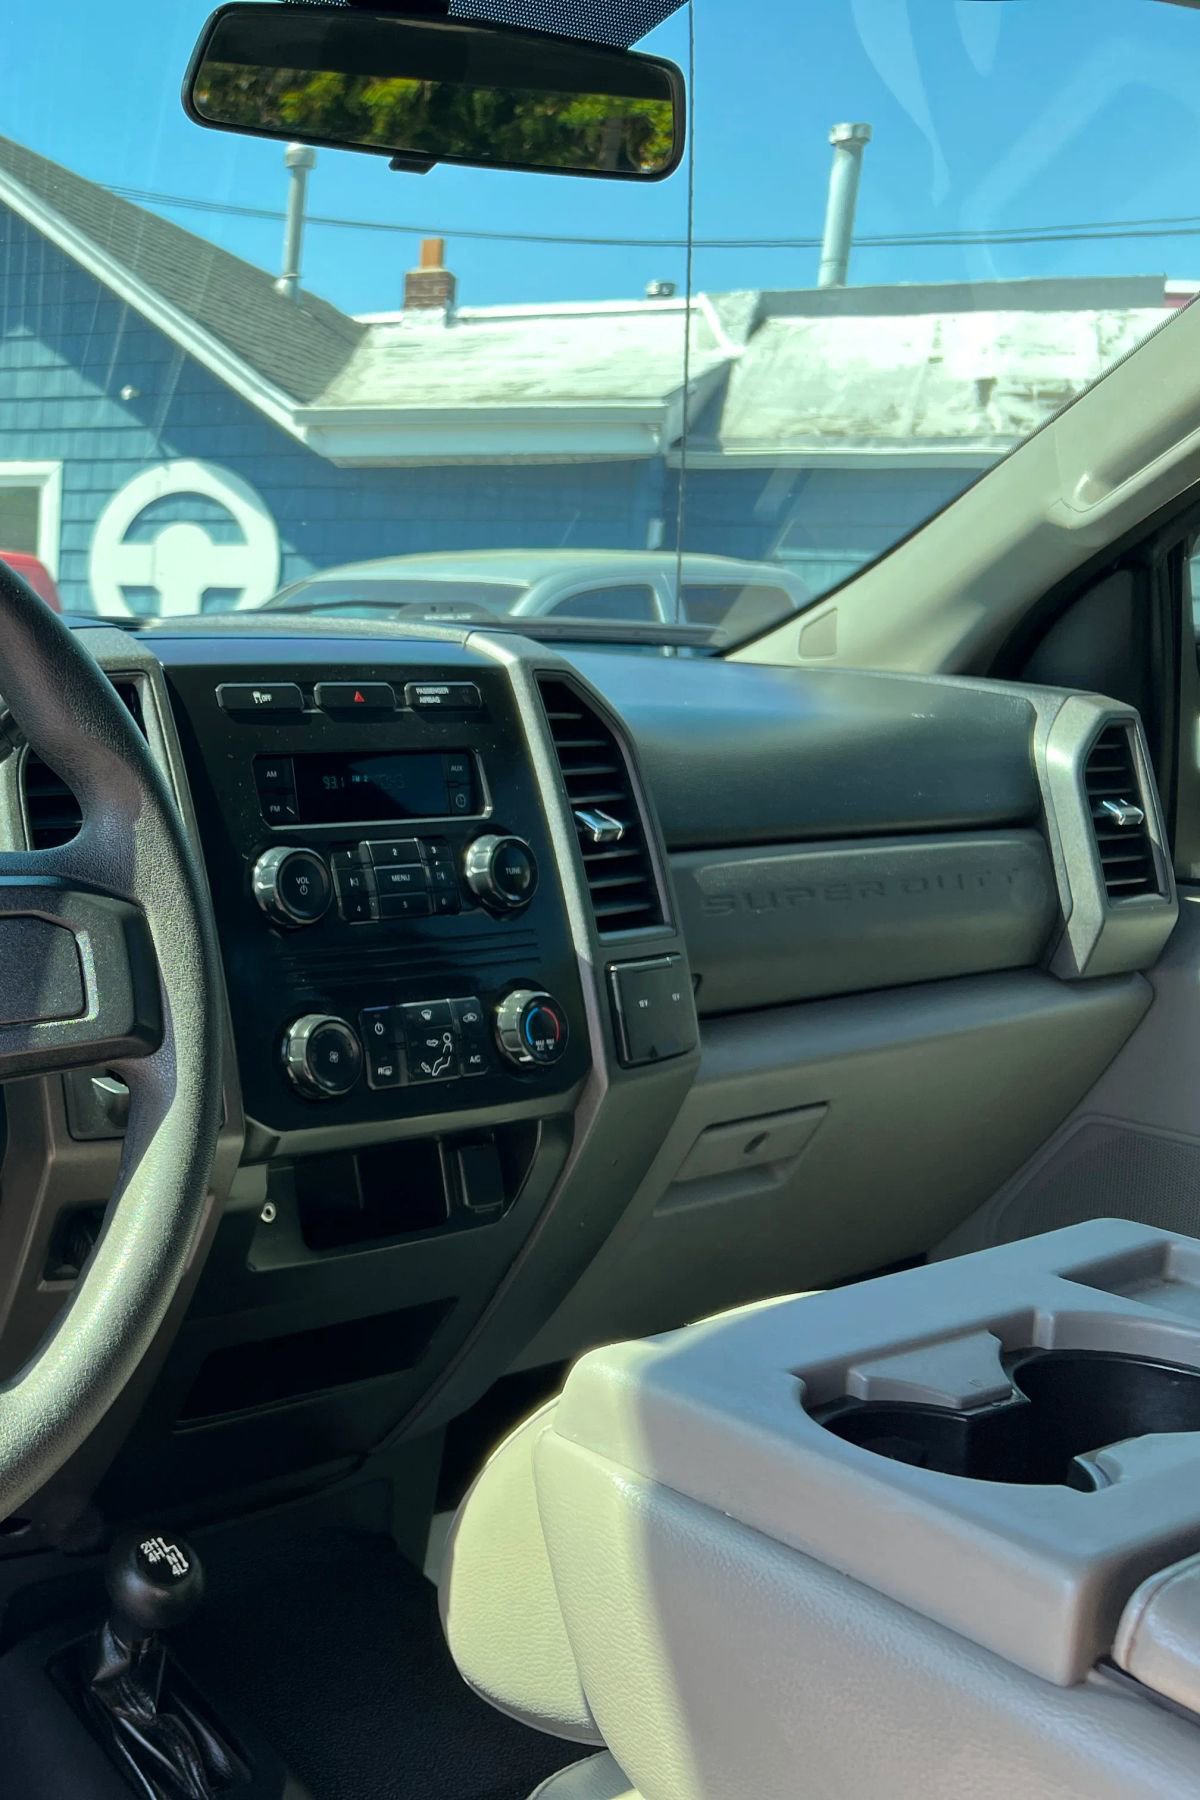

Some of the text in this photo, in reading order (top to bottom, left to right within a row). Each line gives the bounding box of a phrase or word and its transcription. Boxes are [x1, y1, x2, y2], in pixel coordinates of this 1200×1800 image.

[450, 764, 464, 773] AUX
[266, 769, 278, 779] AM
[269, 804, 281, 813] FM
[392, 847, 398, 857] 2
[431, 845, 437, 854] 3
[505, 866, 521, 875] TUNE
[295, 876, 310, 885] VOL
[391, 873, 411, 883] MENU
[704, 880, 886, 918] SUPER
[470, 1054, 481, 1064] A/C
[140, 1538, 159, 1555] 2H
[148, 1547, 166, 1563] 4H
[166, 1552, 179, 1566] N
